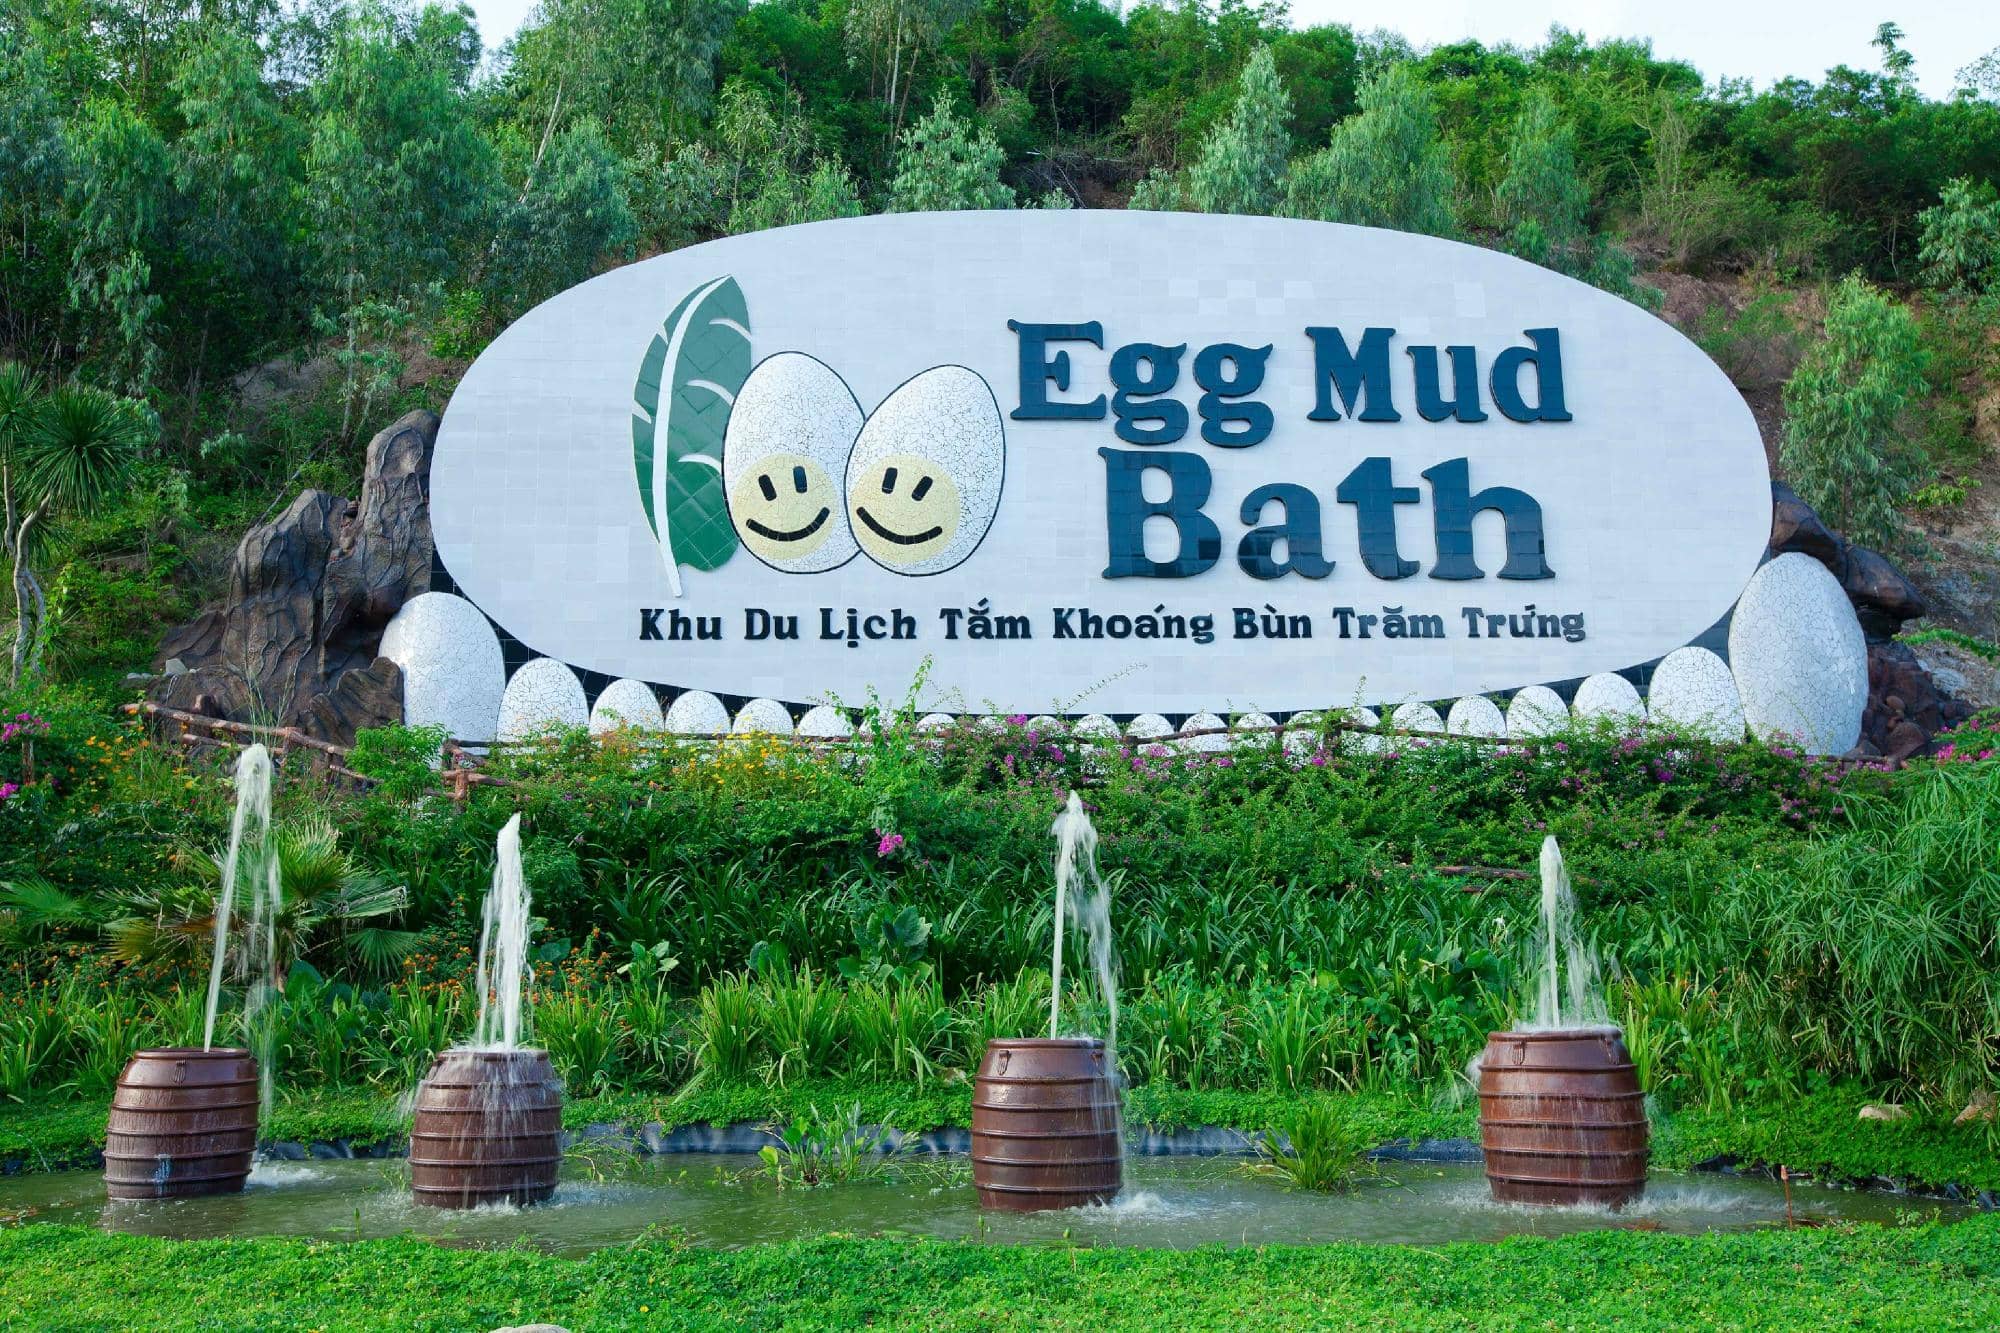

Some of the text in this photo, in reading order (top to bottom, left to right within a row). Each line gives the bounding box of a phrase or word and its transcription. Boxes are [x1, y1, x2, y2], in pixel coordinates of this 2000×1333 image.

[1007, 318, 1574, 449] Egg Mud
[1098, 446, 1558, 584] Bath
[638, 597, 1588, 649] Khu Du Lịch Tắm Khoáng Bùn Trăm Trứng
